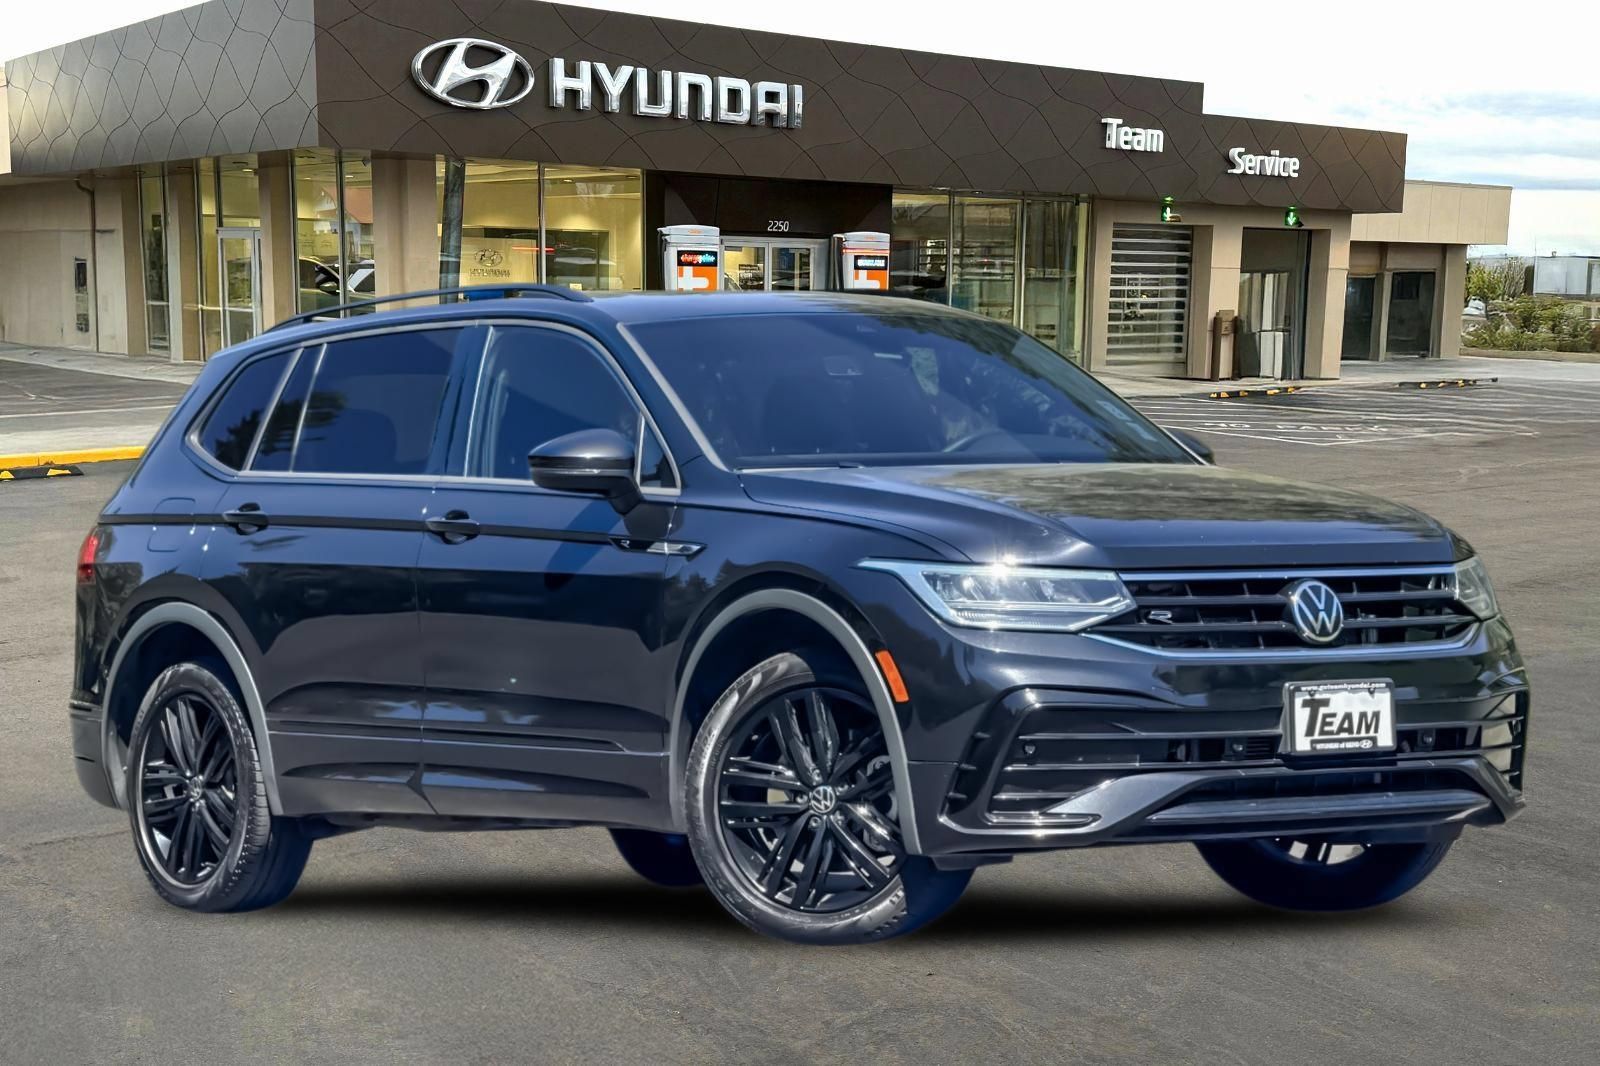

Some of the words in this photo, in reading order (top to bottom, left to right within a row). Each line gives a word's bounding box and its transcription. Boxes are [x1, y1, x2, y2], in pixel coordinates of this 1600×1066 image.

[548, 57, 802, 129] HYUNDAI
[1101, 117, 1165, 153] Team
[1227, 147, 1300, 178] Service
[767, 220, 790, 232] 2250
